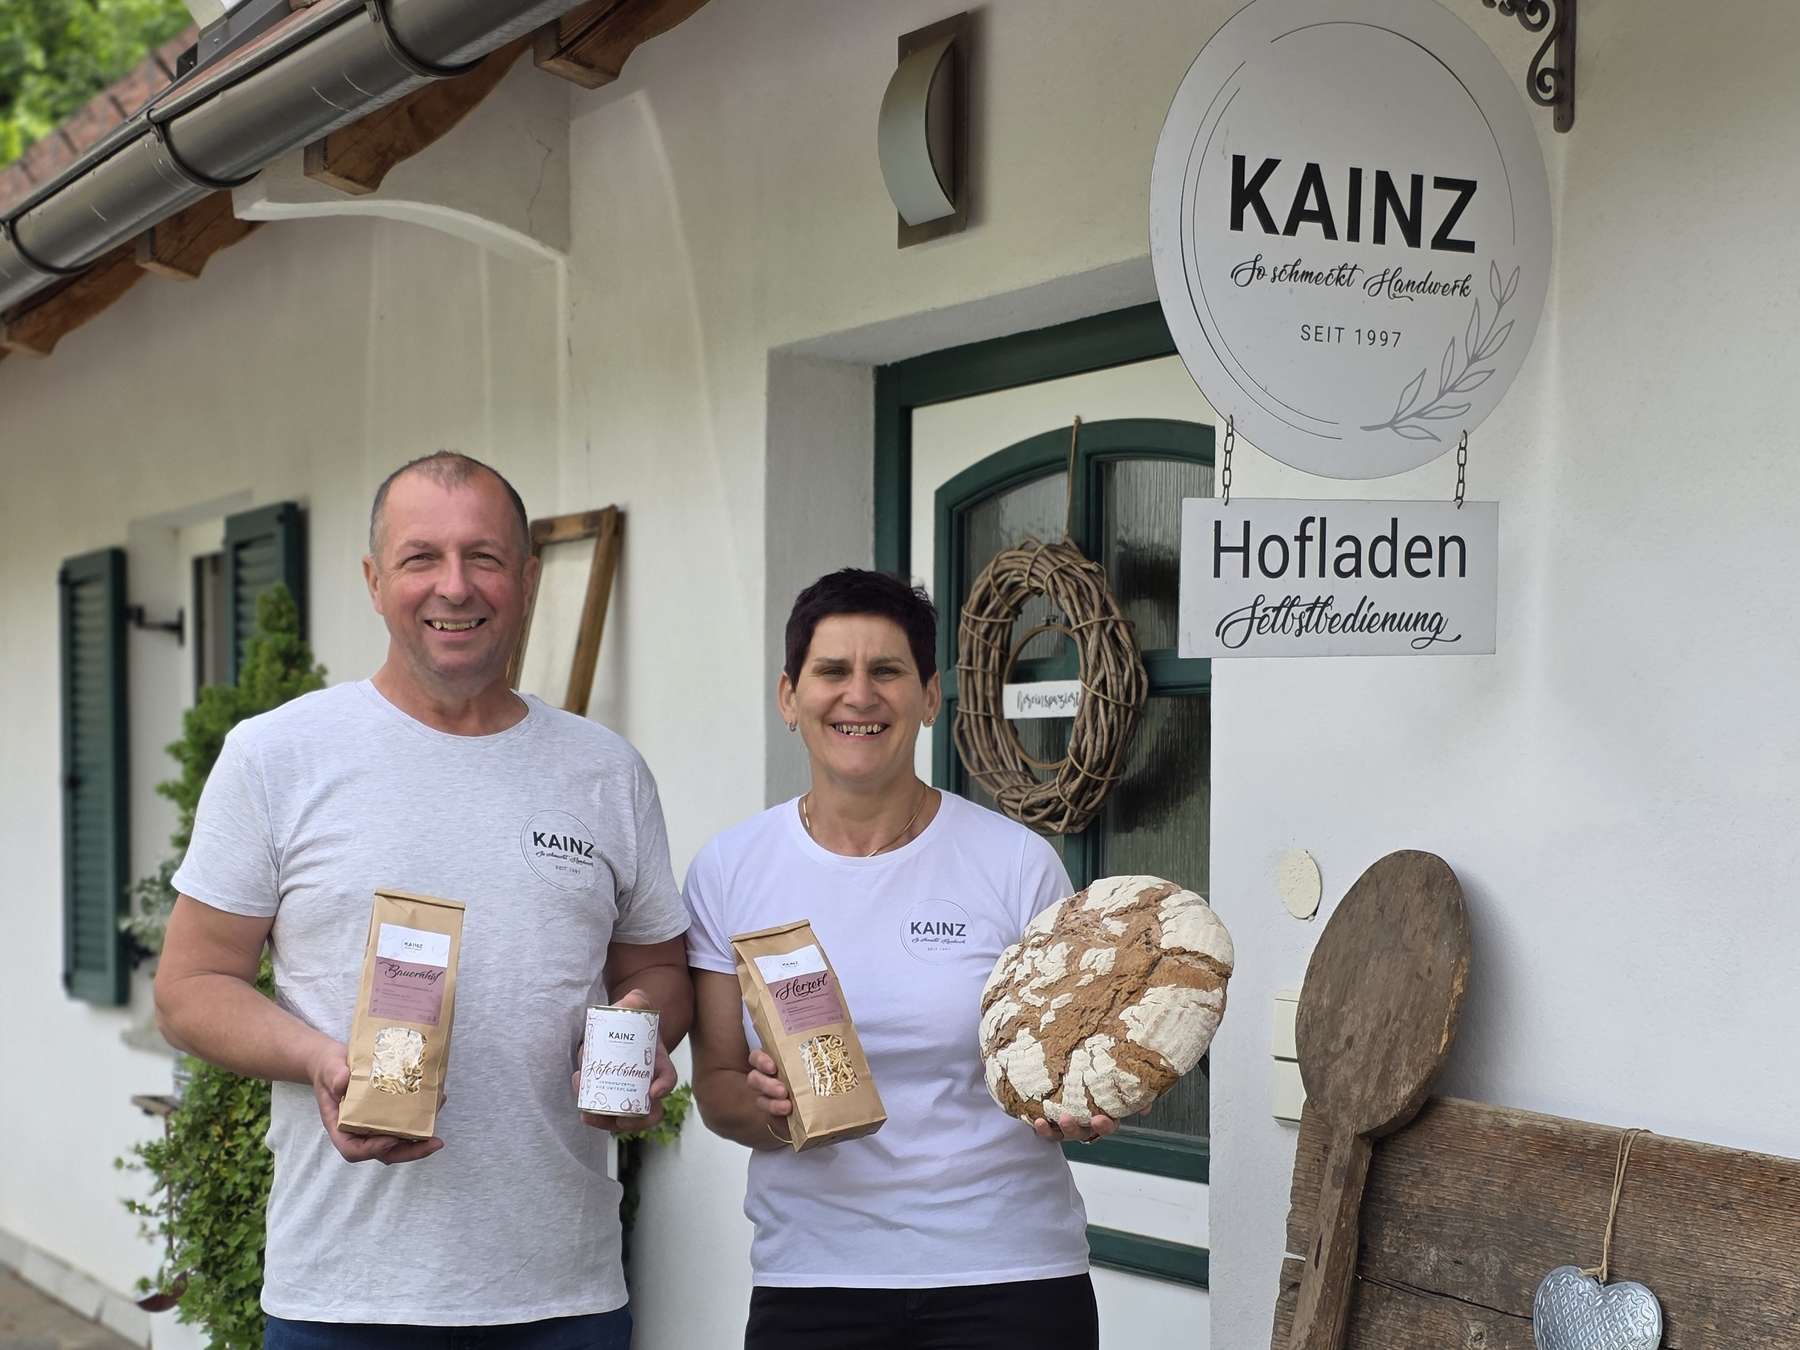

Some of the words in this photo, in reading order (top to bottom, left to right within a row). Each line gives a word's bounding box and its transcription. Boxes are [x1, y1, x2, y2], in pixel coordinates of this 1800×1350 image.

[1229, 153, 1478, 254] KAINZ
[1230, 254, 1268, 289] So
[1269, 257, 1364, 289] schmeckt
[1363, 266, 1473, 302] Handwerk
[1300, 324, 1345, 345] SEIT
[1354, 328, 1402, 349] 1997
[1213, 516, 1467, 579] Hofladen
[1214, 594, 1462, 650] Selbstbedienung
[532, 831, 595, 859] KAINZ
[910, 921, 967, 937] KAINZ
[608, 1031, 636, 1041] KAINZ
